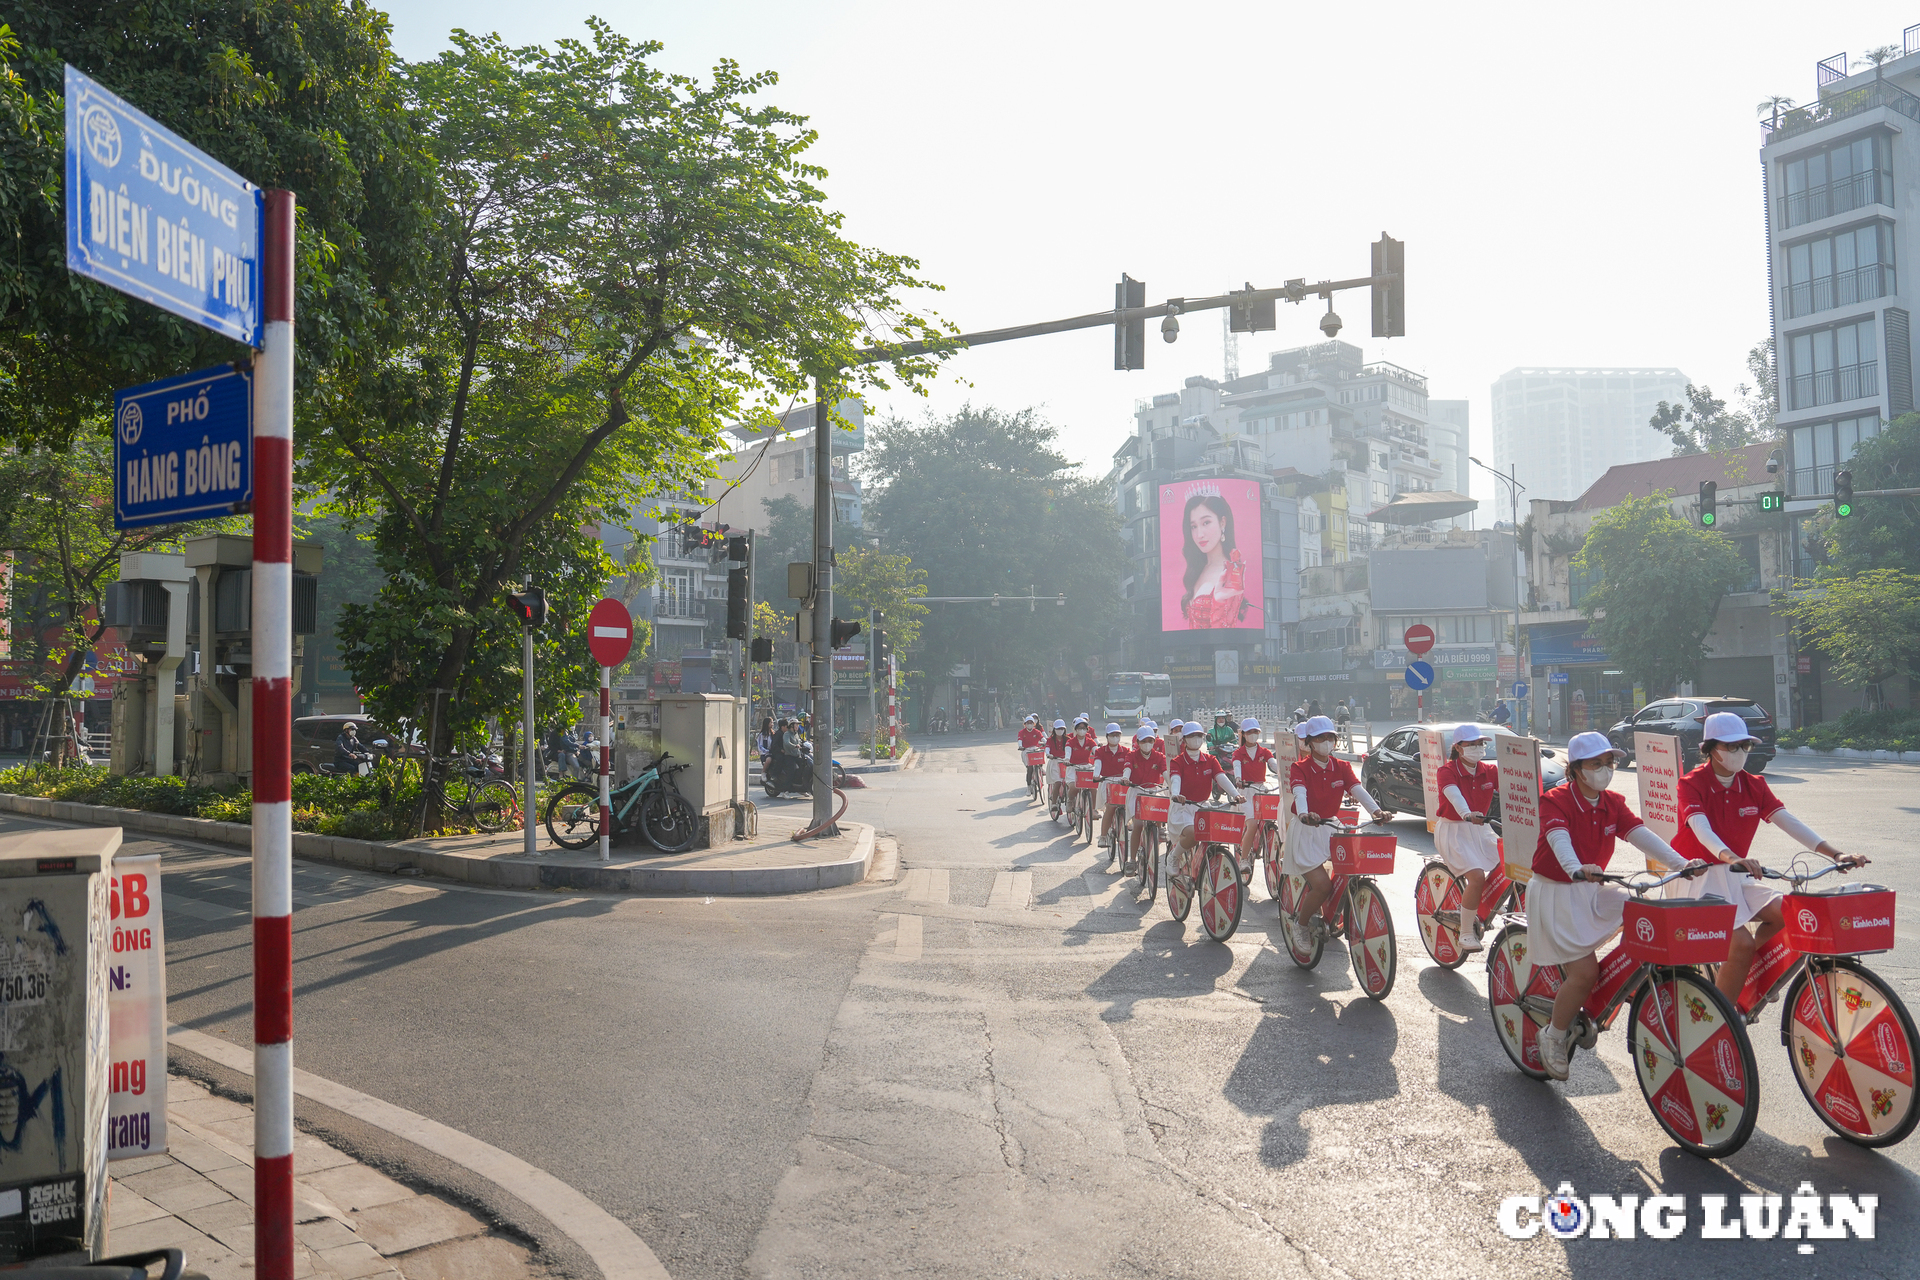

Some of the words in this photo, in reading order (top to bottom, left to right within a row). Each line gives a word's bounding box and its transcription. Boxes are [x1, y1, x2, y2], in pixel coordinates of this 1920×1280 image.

[139, 148, 239, 229] ĐƯỜNG
[90, 180, 149, 270] ĐIỆN
[157, 216, 206, 292] BIÊN
[212, 242, 250, 312] PHỦ
[167, 385, 212, 426] PHỐ
[127, 449, 179, 505] HÀNG
[185, 435, 241, 496] BÔNG
[1451, 652, 1469, 663] BIẾU
[1470, 653, 1491, 662] 9999
[1283, 675, 1307, 683] TWITTER
[1308, 674, 1327, 682] BEANS
[1329, 673, 1350, 681] COFFEE
[1514, 768, 1522, 778] HÀ
[1522, 772, 1534, 781] NỘI
[1642, 764, 1654, 774] PHỞ
[1654, 766, 1663, 776] HÀ
[1663, 769, 1674, 778] NỘI
[1510, 782, 1517, 791] DI
[1517, 783, 1528, 793] SẢN
[1650, 780, 1656, 788] DI
[1657, 779, 1668, 790] SẢN
[1507, 792, 1519, 801] VĂN
[1520, 795, 1532, 805] HÓA
[1647, 789, 1659, 799] VĂN
[1660, 792, 1673, 802] HÓA
[1505, 802, 1514, 812] PHI
[1515, 805, 1525, 815] VẬT
[1645, 800, 1655, 809] PHI
[1655, 802, 1665, 812] VẬT
[1508, 813, 1524, 825] QUỐC
[1525, 818, 1535, 828] GIA
[1648, 810, 1664, 822] QUỐC
[1665, 815, 1676, 824] GIA
[110, 926, 152, 953] ÔNG
[1772, 943, 1784, 954] NAM
